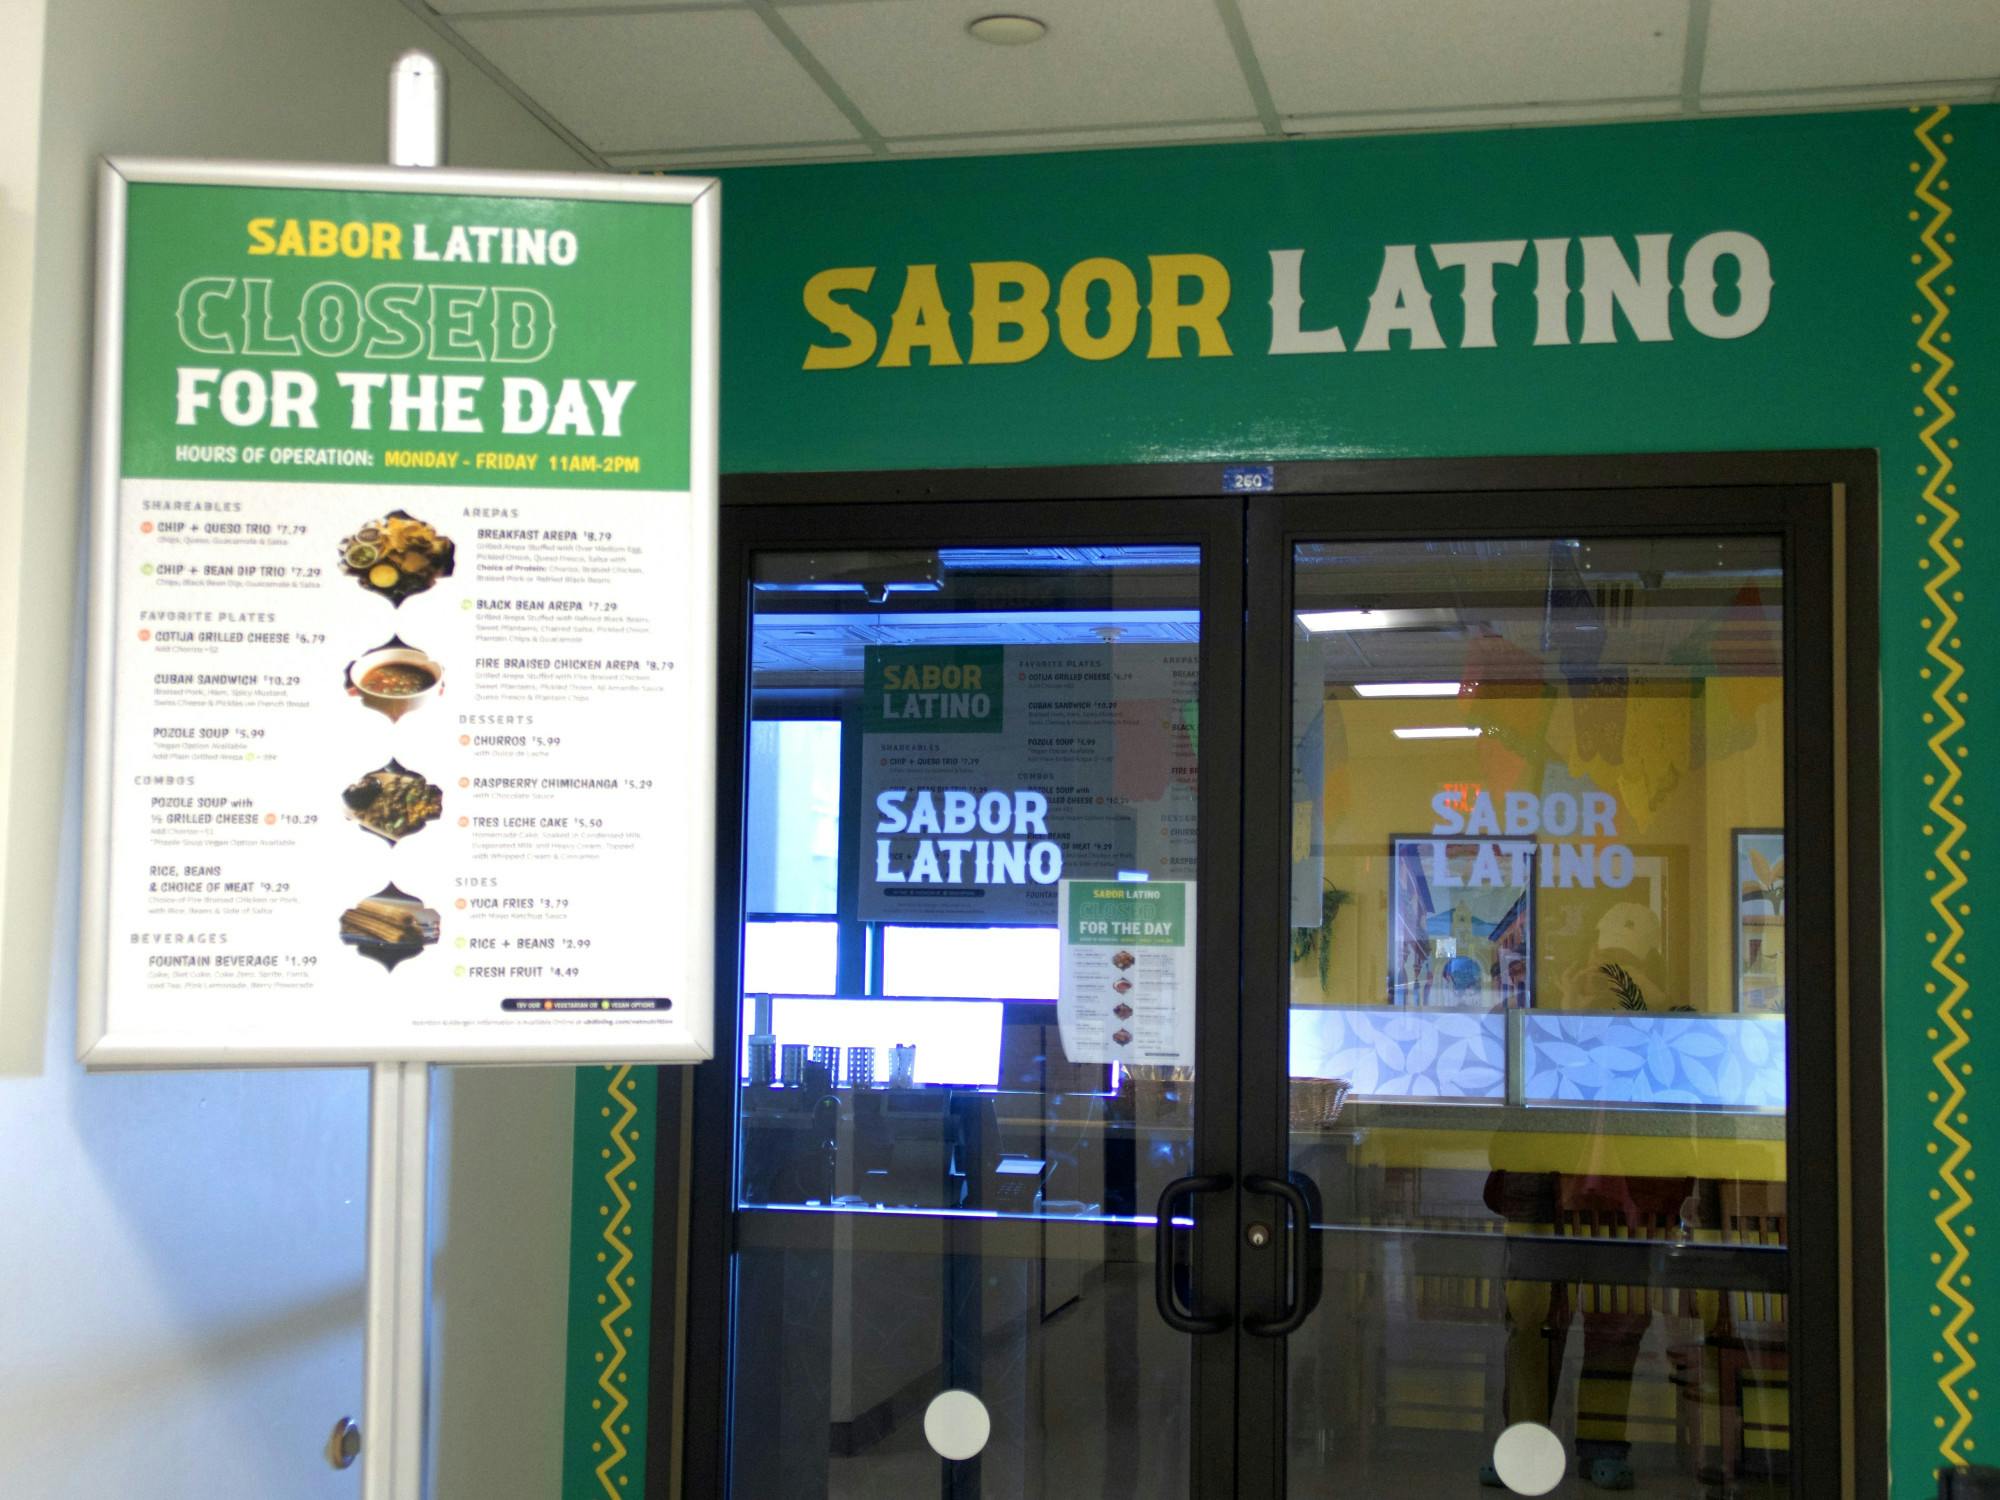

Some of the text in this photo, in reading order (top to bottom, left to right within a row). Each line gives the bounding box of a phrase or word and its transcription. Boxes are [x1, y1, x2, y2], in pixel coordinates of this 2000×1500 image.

[248, 218, 578, 266] SABOR LATINO
[802, 230, 1776, 371] SABOR LATINO
[175, 276, 558, 363] CLOSED
[175, 366, 637, 437] FOR THE DAY
[176, 444, 236, 464] HOURS
[242, 446, 265, 464] OF
[270, 446, 374, 467] OPERATION:
[384, 450, 460, 469] MONDAY
[476, 452, 538, 471] FRIDAY
[549, 454, 640, 474] 11AM-2PM
[142, 500, 241, 512] SHAREABLES
[463, 508, 520, 518] AREPAS
[158, 522, 184, 532] CHIP
[190, 524, 199, 532] +
[204, 523, 240, 534] QUESO
[246, 524, 271, 534] TRIO
[477, 529, 539, 540] BREAKFAST
[543, 530, 578, 540] AREPA
[156, 564, 183, 575] CHIP
[189, 566, 198, 574] +
[203, 565, 233, 576] BEAN
[237, 566, 256, 576] DIP
[261, 566, 286, 577] TRIO
[476, 599, 512, 610] BLACK
[516, 600, 544, 610] BEAN
[548, 600, 583, 611] AREPA
[140, 610, 276, 622] FAVORITE PLATES
[155, 631, 194, 642] COTIJA
[198, 632, 243, 643] GRILLED
[247, 632, 290, 643] CHEESE
[476, 658, 499, 668] FIRE
[504, 658, 550, 669] BRAISED
[554, 659, 602, 670] CHICKEN
[606, 660, 640, 670] AREPA
[154, 674, 193, 684] CUBAN
[198, 674, 257, 685] SANDWICH
[883, 665, 982, 690] SABOR
[883, 693, 990, 718] LATINO
[459, 715, 534, 725] DESSERTS
[153, 727, 195, 738] POZOLE
[199, 728, 229, 738] SOUP
[474, 736, 526, 746] CHURROS
[134, 776, 195, 786] COMBOS
[473, 777, 538, 788] RASPBERRY
[541, 778, 618, 789] CHIMICHANGA
[151, 797, 253, 808] POZOLE SOUP with
[876, 790, 1048, 834] SABOR
[1431, 791, 1618, 837] SABOR
[166, 814, 212, 824] GRILLED
[216, 814, 259, 824] CHEESE
[472, 816, 499, 827] TRES
[503, 817, 536, 827] LECHE
[540, 817, 568, 827] CAKE
[875, 839, 1063, 884] LATINO
[1431, 843, 1634, 889] LATINO
[150, 866, 221, 877] RICE, BEANS
[160, 882, 203, 892] CHOICE
[206, 882, 221, 892] OF
[224, 882, 255, 892] MEAT
[456, 877, 498, 887] SIDES
[1093, 888, 1160, 900] SABOR LATINO
[470, 898, 498, 909] YUCA
[503, 898, 534, 909] FRIES
[1080, 922, 1172, 936] FOR THE DAY
[130, 933, 228, 944] BEVERAGES
[469, 938, 496, 949] RICE
[502, 940, 511, 948] +
[517, 938, 555, 949] BEANS
[149, 955, 210, 967] FOUNTAIN
[215, 955, 278, 966] BEVERAGE
[469, 967, 505, 978] FRESH
[510, 967, 543, 978] FRUIT
